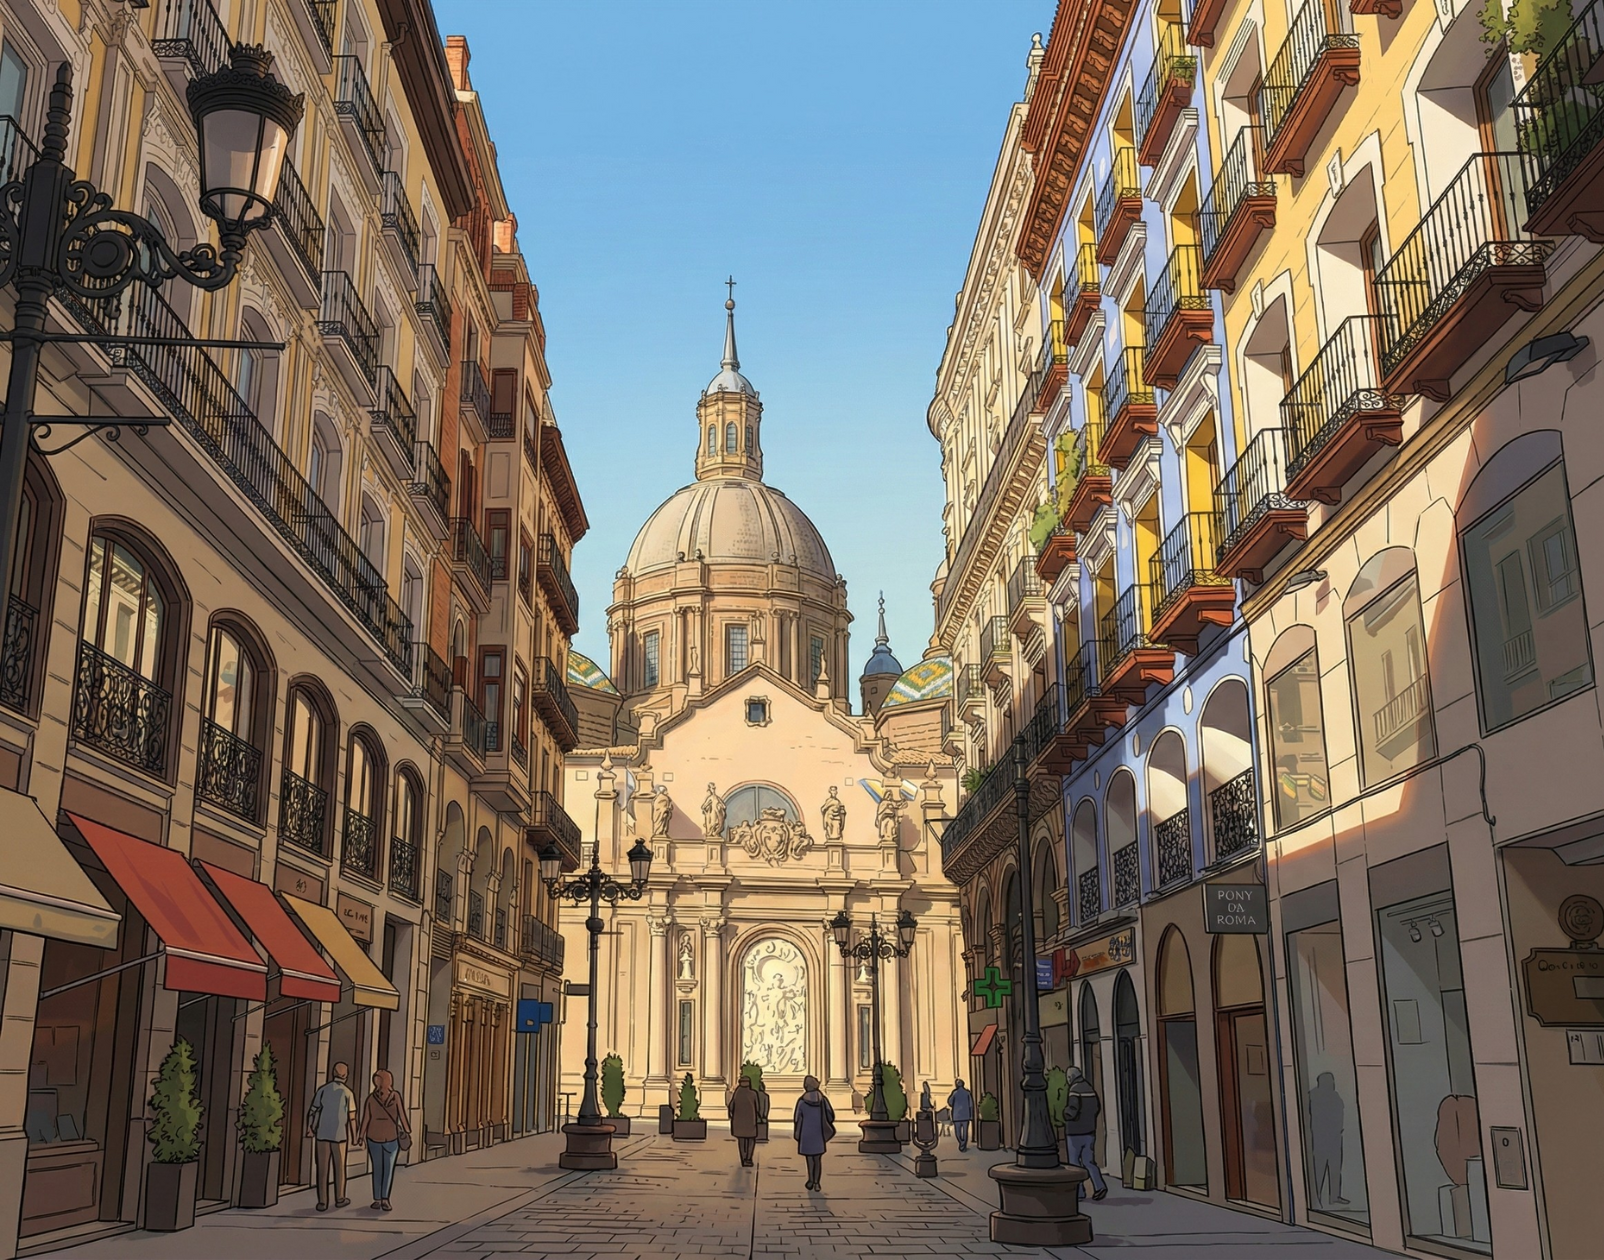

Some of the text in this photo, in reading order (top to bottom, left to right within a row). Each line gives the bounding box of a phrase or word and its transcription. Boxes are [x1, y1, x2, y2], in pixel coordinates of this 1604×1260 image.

[1217, 890, 1253, 901] PONY
[1227, 903, 1245, 913] DA
[1217, 915, 1256, 925] ROMA
